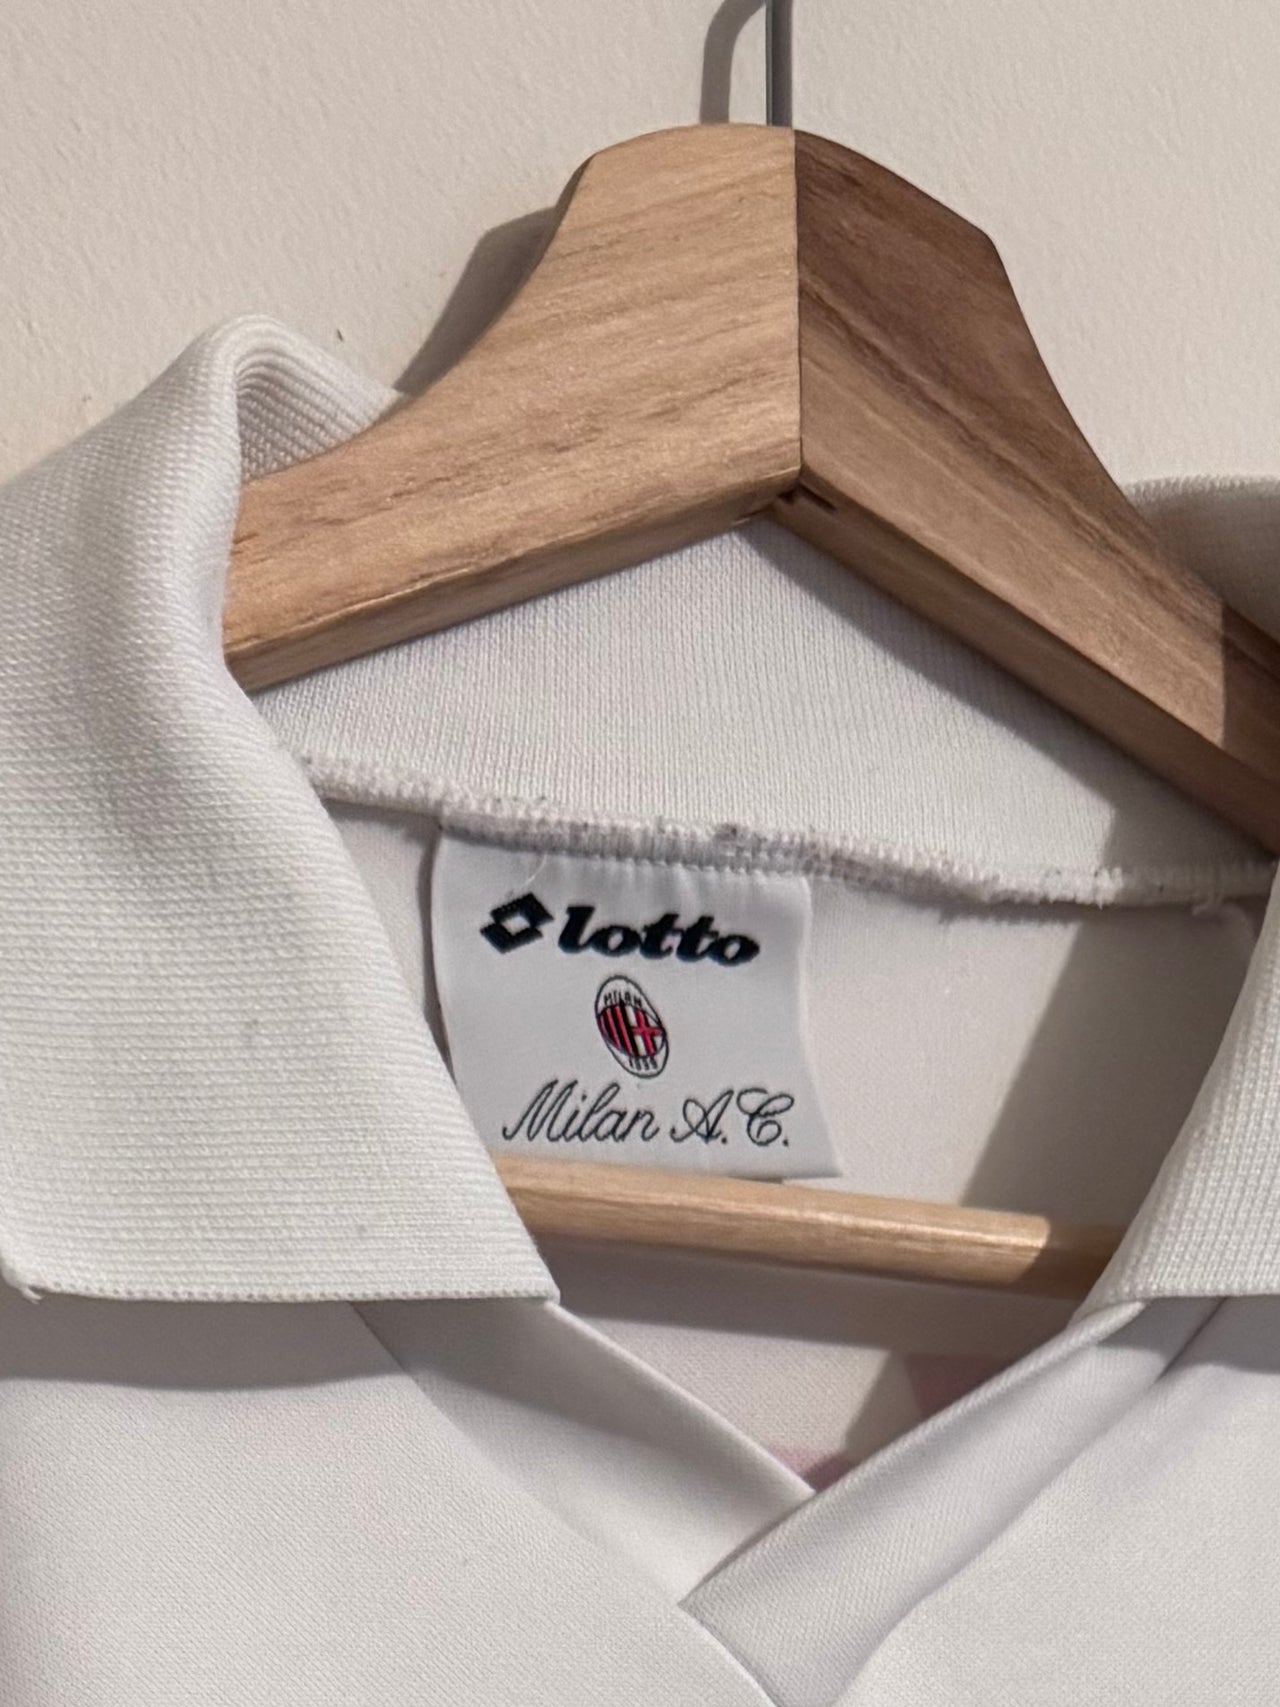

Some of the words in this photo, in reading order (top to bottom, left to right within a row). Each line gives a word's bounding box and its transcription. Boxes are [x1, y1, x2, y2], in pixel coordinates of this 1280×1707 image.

[557, 905, 761, 967] lotto
[502, 1079, 661, 1143] Milan
[670, 1087, 795, 1147] A.C.
